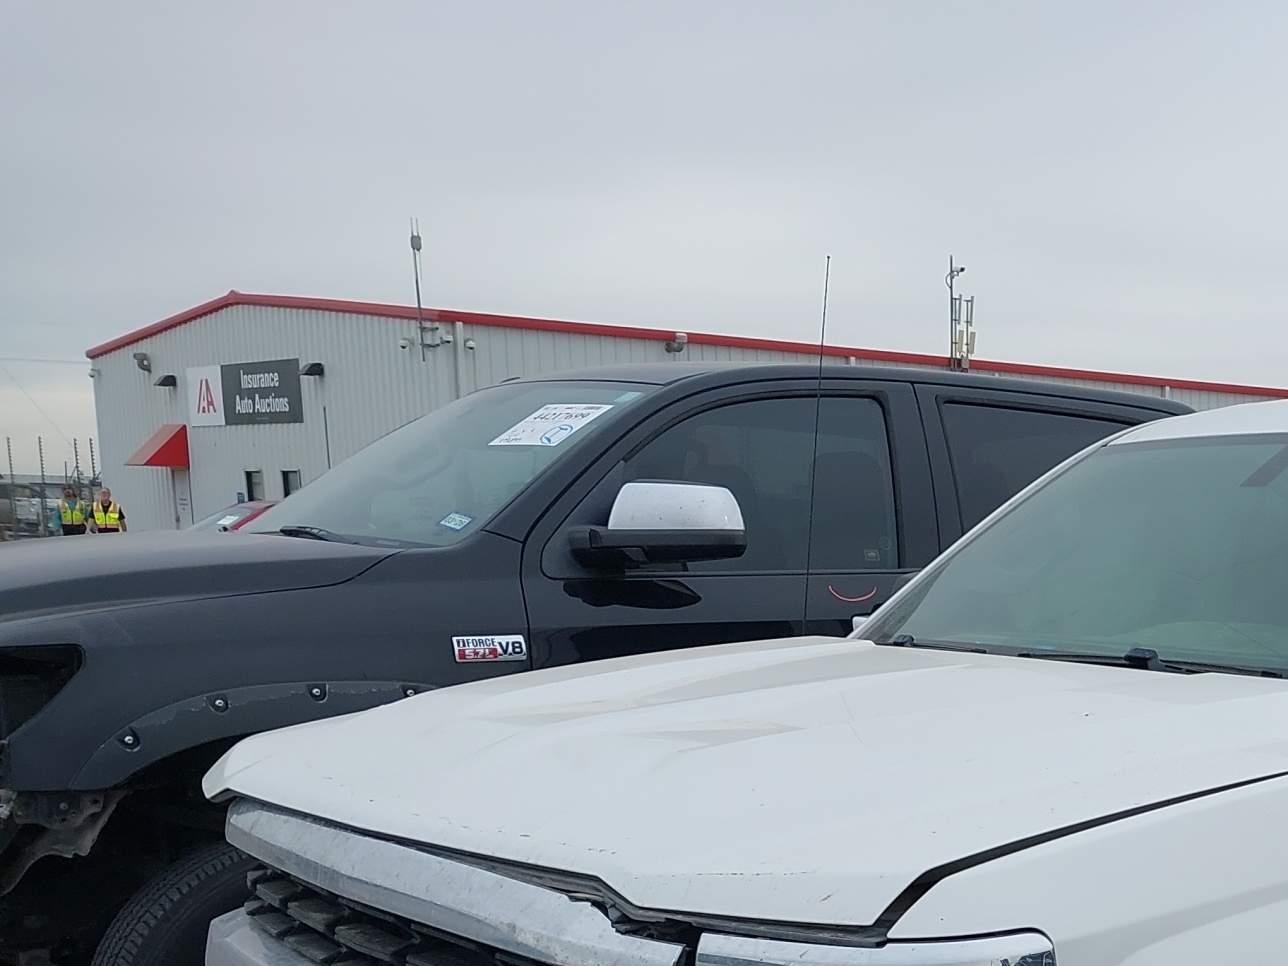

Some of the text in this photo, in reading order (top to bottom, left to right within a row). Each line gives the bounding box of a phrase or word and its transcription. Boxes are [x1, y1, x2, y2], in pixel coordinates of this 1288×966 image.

[240, 369, 279, 388] Insurance
[235, 393, 289, 414] Auto Auctions
